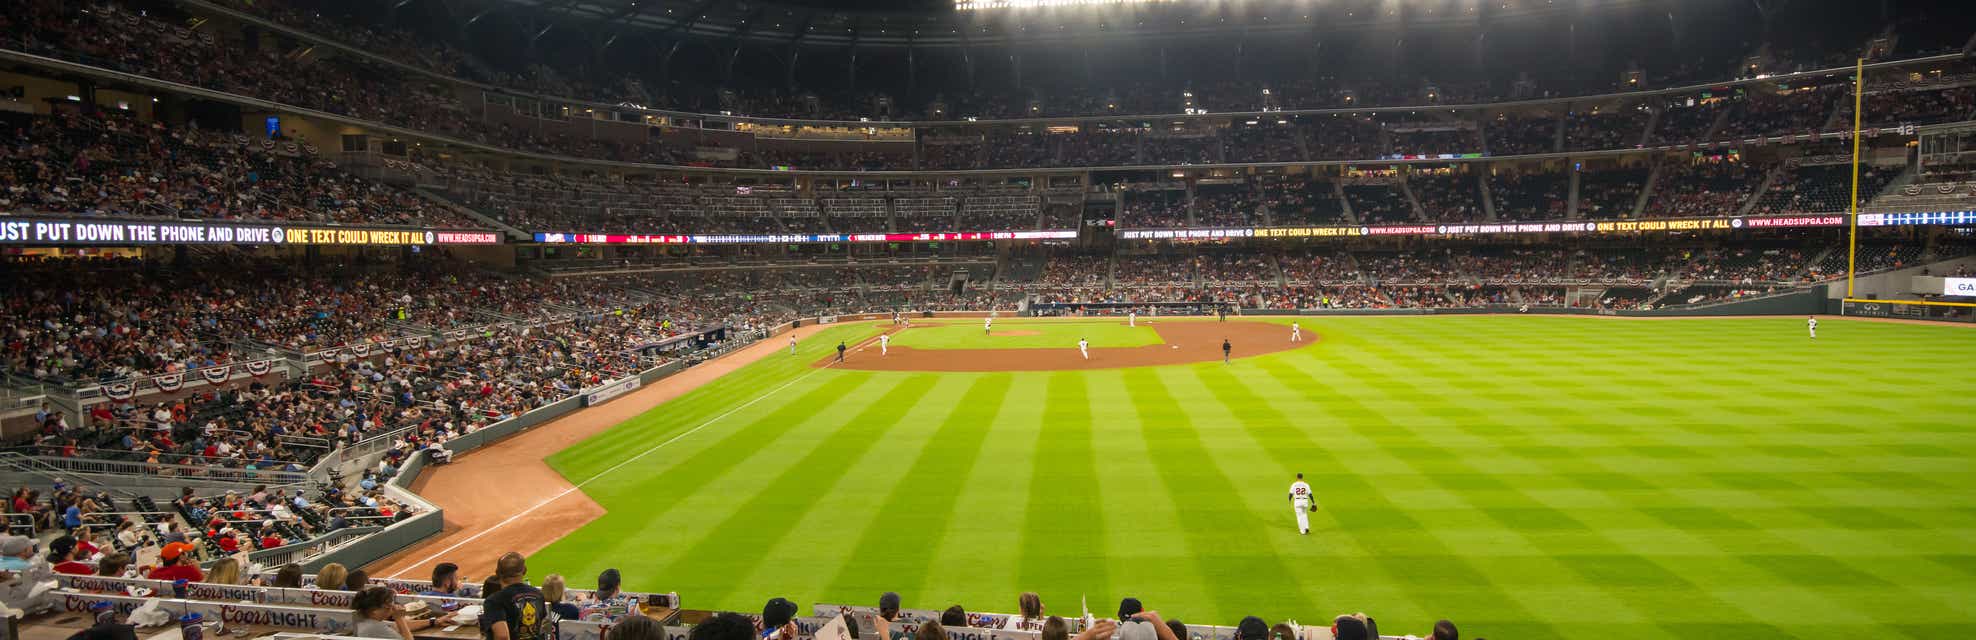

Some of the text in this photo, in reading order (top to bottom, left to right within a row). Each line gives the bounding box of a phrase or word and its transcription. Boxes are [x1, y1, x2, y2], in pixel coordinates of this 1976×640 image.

[1597, 220, 1729, 231] ONE TEXT COULD WRECK IT ALL
[1749, 217, 1842, 227] WWW.HEADSUPGA.COM
[36, 223, 71, 241] PUT
[76, 225, 124, 241] DOWN
[128, 225, 157, 242] THE
[161, 226, 204, 242] PHONE
[208, 227, 233, 243] AND
[237, 228, 269, 243] DRIVE
[1124, 231, 1139, 239] JUST
[1140, 231, 1153, 239] PUT
[1175, 230, 1187, 238] THE
[1189, 230, 1209, 238] PHONE
[1211, 230, 1224, 238] AND
[1225, 229, 1244, 237] DRIVE
[1254, 228, 1360, 237] ONE TEXT COULD WRECK IT ALL
[1369, 226, 1435, 234] WWW.HEADSUPGA.COM
[1447, 226, 1463, 234] JUST
[1480, 225, 1501, 233] DOWN
[1518, 225, 1543, 233] PHONE
[1545, 224, 1560, 232] AND
[1562, 223, 1585, 232] DRIVE
[287, 228, 424, 244] ONE TEXT COULD WRECK IT ALL
[1295, 487, 1306, 496] 22
[187, 584, 257, 601] Coors LIGHT
[311, 591, 350, 607] Coors
[219, 604, 318, 629] Coors LIGHT
